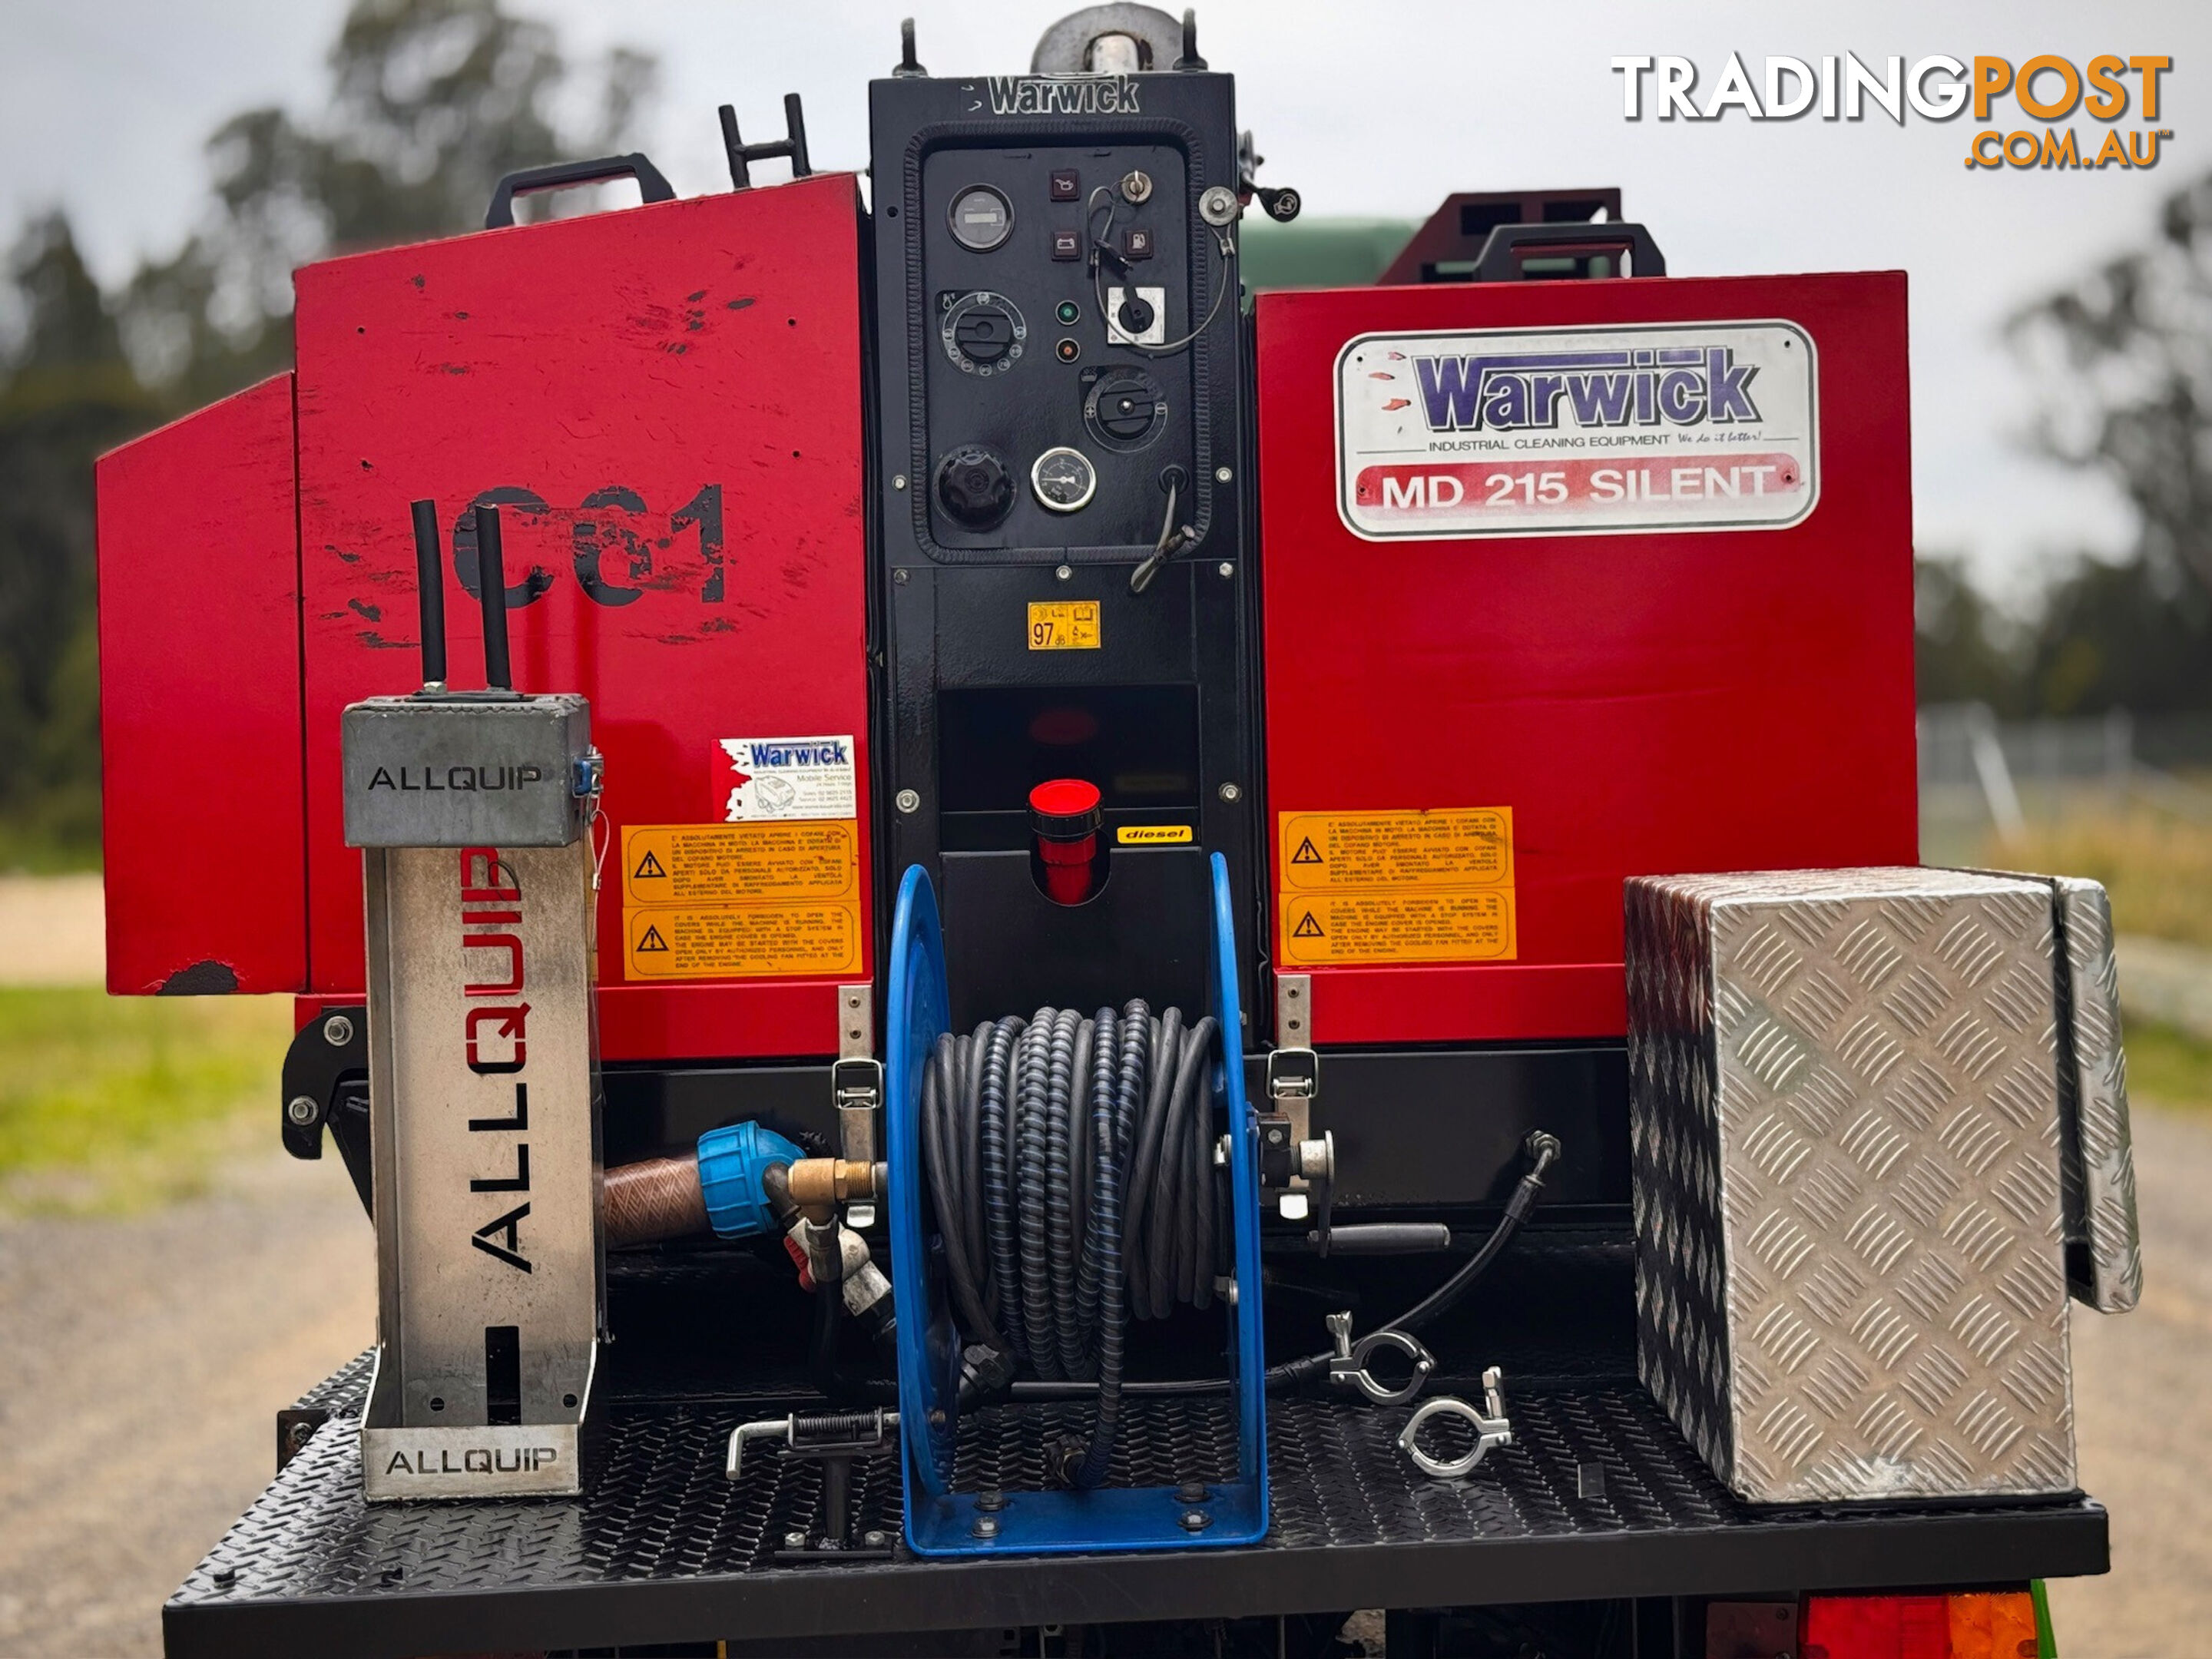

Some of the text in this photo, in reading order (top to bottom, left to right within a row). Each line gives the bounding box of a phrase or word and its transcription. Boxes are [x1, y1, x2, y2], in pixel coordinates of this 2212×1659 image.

[988, 76, 1141, 114] Warwick
[1412, 346, 1761, 431] Warwick
[1429, 440, 1509, 452] INDUSTRIAL
[1515, 437, 1585, 449] CLEANING
[1589, 435, 1670, 447] EQUIPMENT
[1678, 432, 1693, 443] We
[1382, 465, 1776, 510] MD 215 SILENT
[1034, 622, 1054, 645] 97
[750, 740, 848, 768] Warwick
[368, 767, 541, 792] ALLQUIP
[1126, 830, 1184, 839] diesel
[461, 847, 532, 1274] ALLQUIP
[386, 1447, 558, 1475] ALLQUIP
